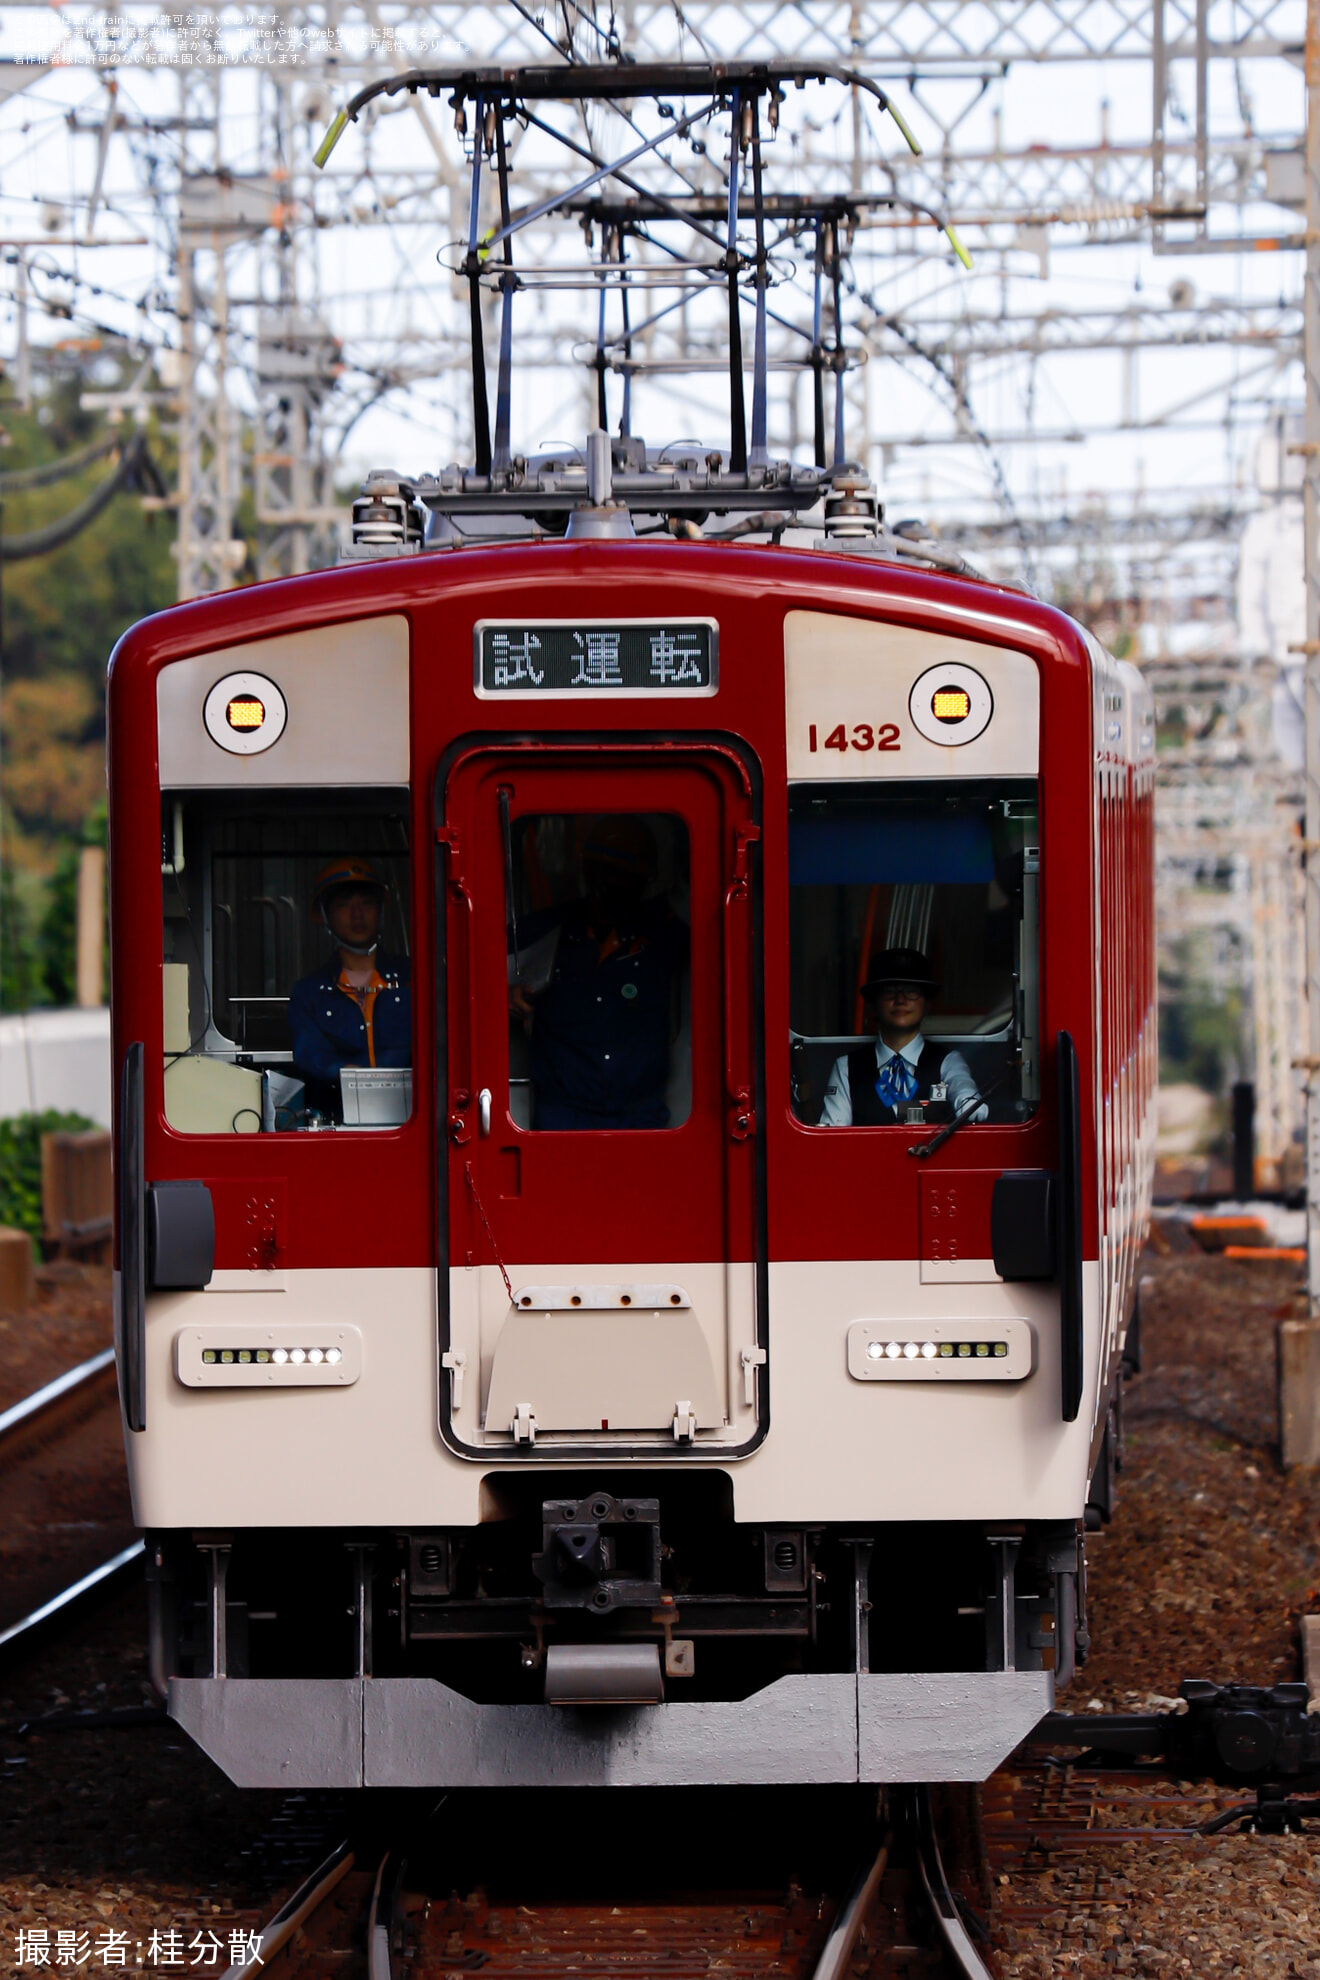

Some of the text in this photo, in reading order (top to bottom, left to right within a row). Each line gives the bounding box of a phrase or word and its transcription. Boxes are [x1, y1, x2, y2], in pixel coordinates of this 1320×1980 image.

[492, 630, 702, 686] 試運転
[809, 723, 901, 753] 1432
